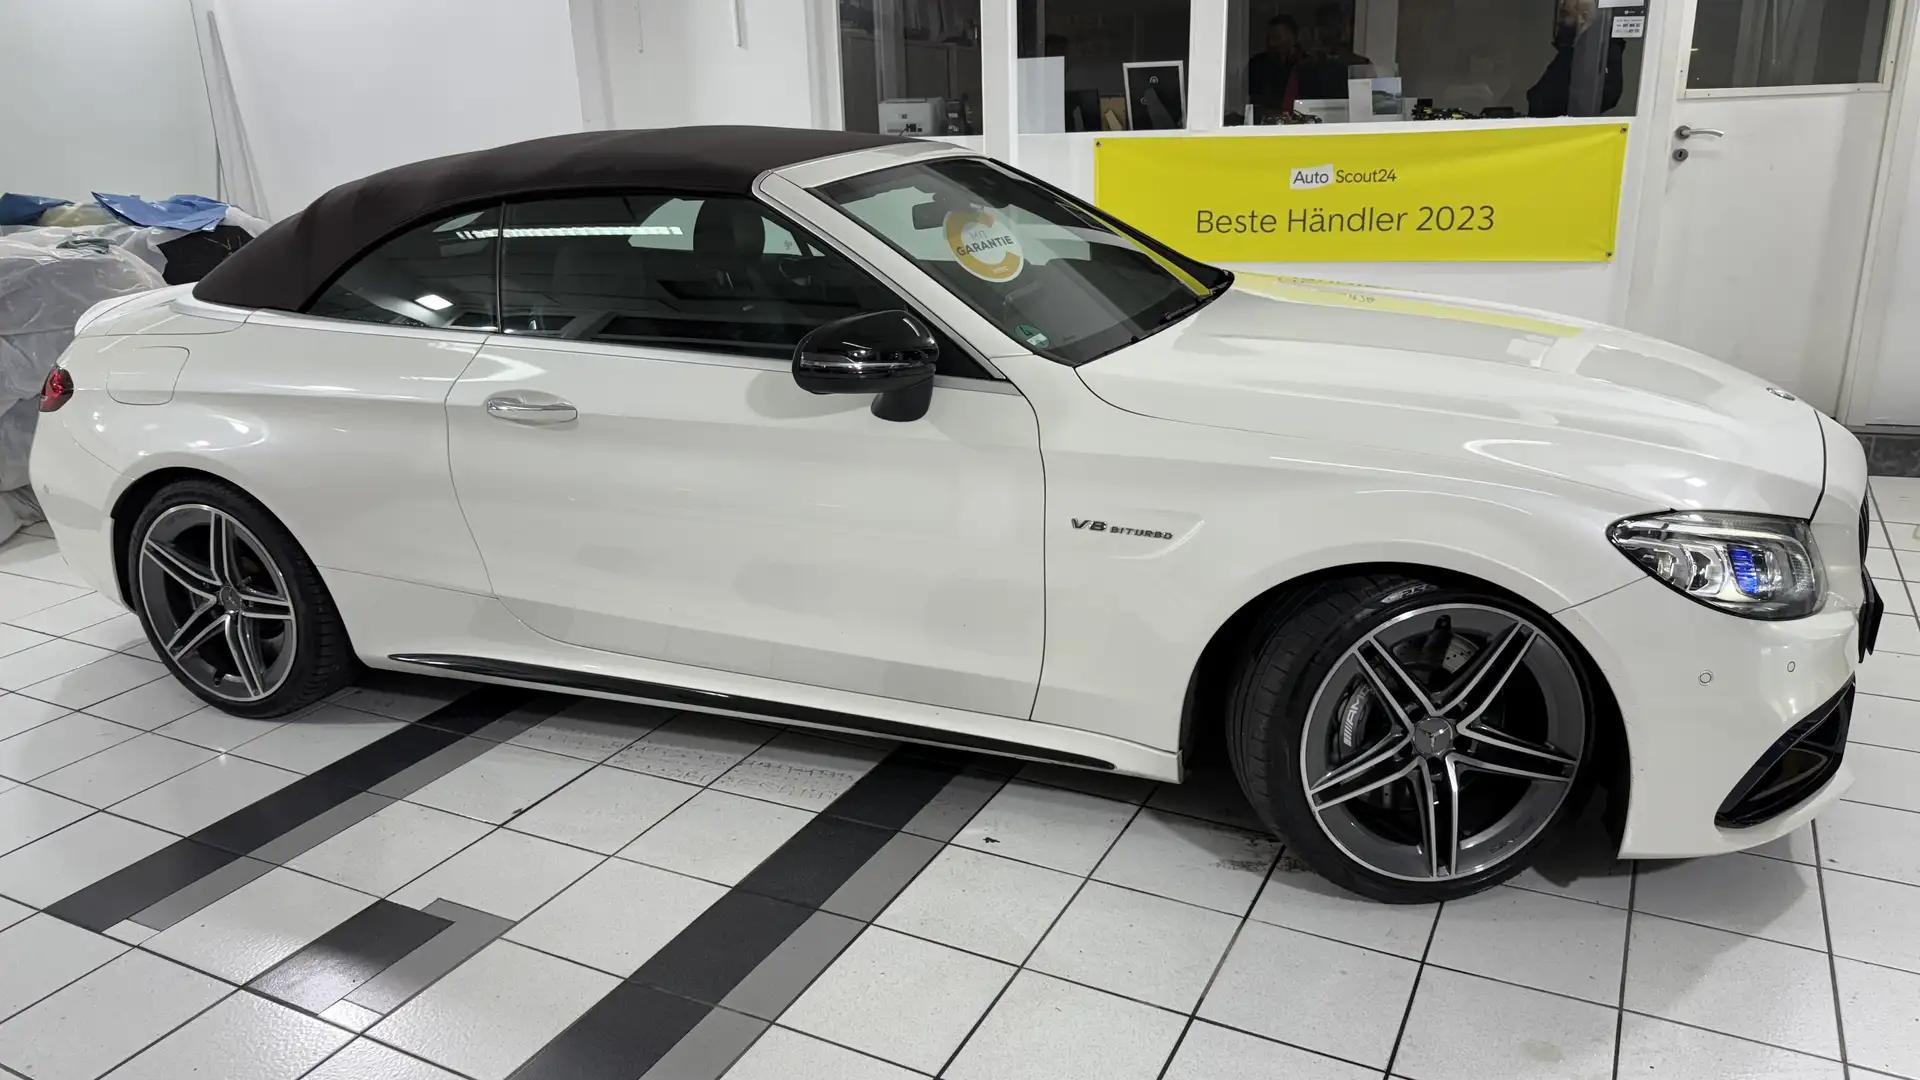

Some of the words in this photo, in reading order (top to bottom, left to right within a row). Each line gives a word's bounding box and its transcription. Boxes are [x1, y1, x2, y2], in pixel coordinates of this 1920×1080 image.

[1293, 171, 1329, 184] Auto
[1336, 168, 1397, 183] Scout24
[1196, 209, 1277, 234] Beste
[1287, 207, 1408, 233] Händler
[1416, 205, 1496, 231] 2023
[956, 235, 1014, 256] GARANTIE
[969, 230, 988, 241] MIT
[1071, 517, 1107, 531] V8
[1110, 526, 1173, 540] BITURBO
